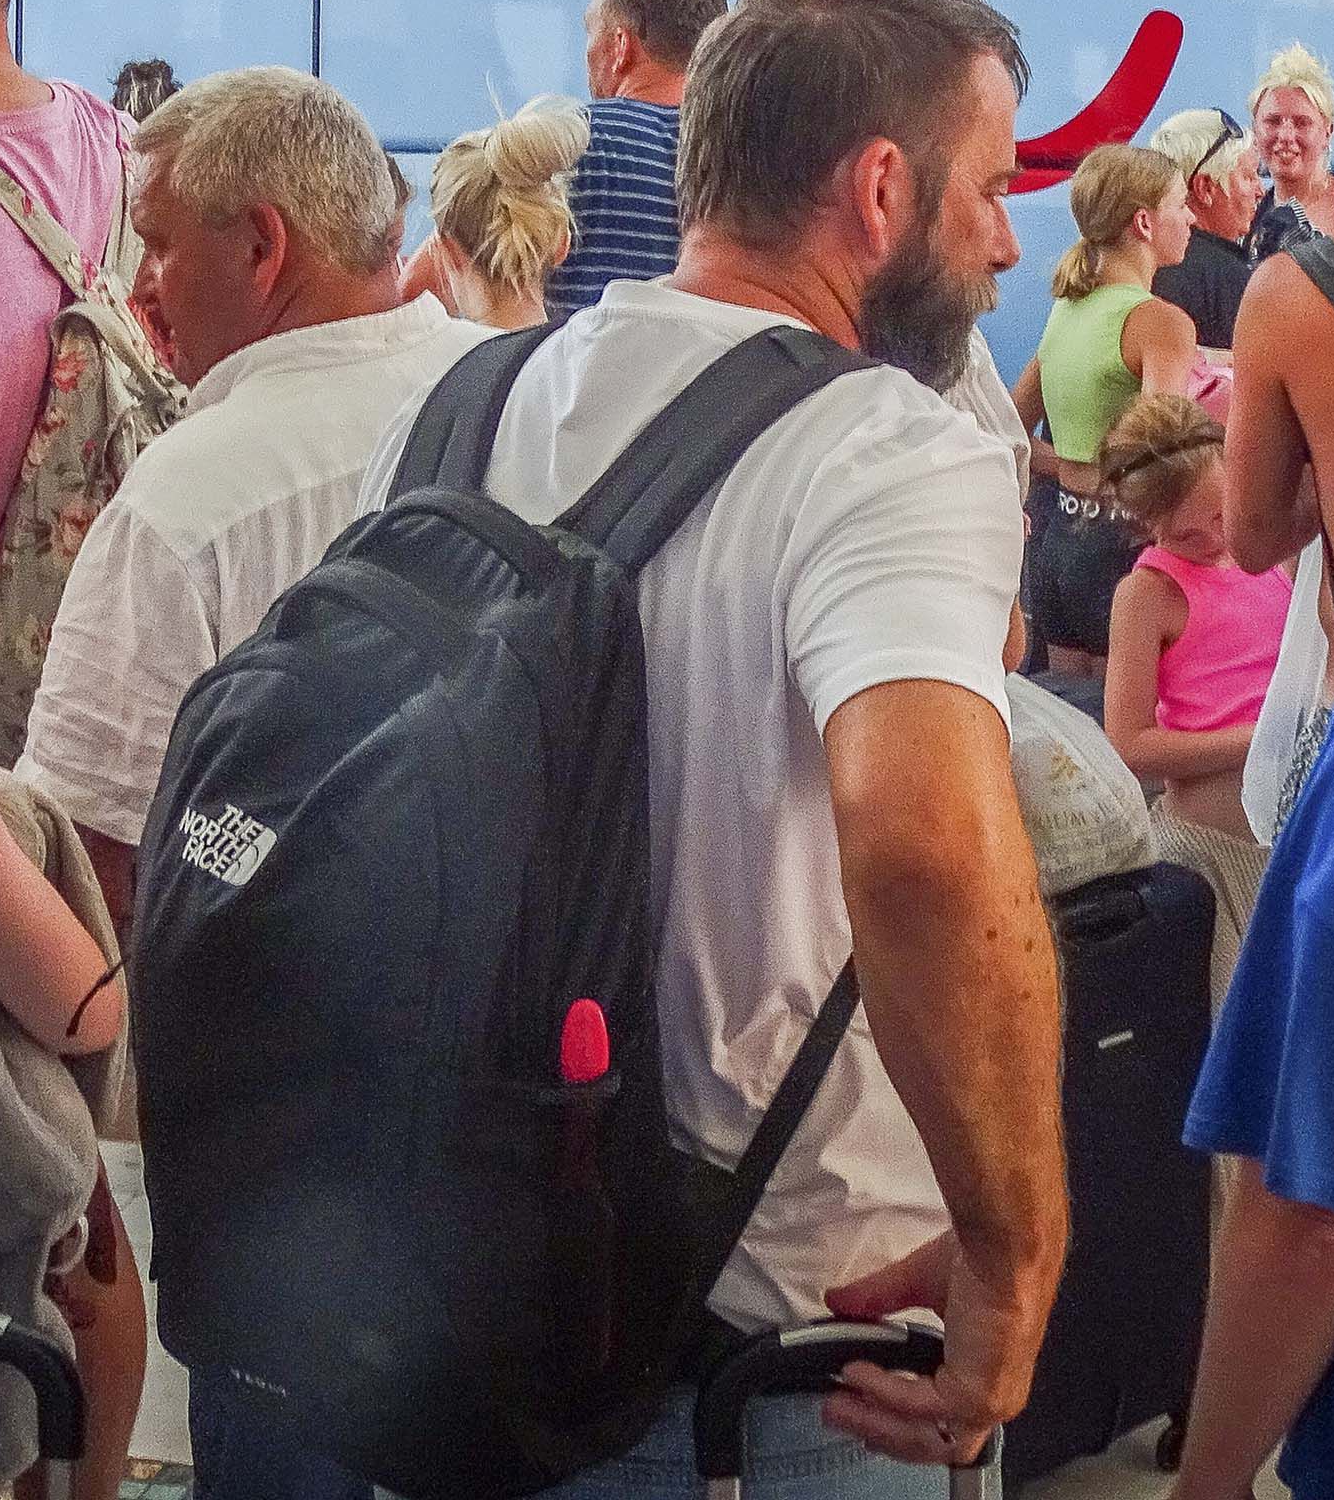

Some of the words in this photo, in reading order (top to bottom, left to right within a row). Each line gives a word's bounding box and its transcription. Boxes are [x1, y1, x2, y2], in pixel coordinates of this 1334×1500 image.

[179, 806, 249, 861] NORTH
[217, 803, 265, 843] THE
[182, 836, 235, 878] FACE
